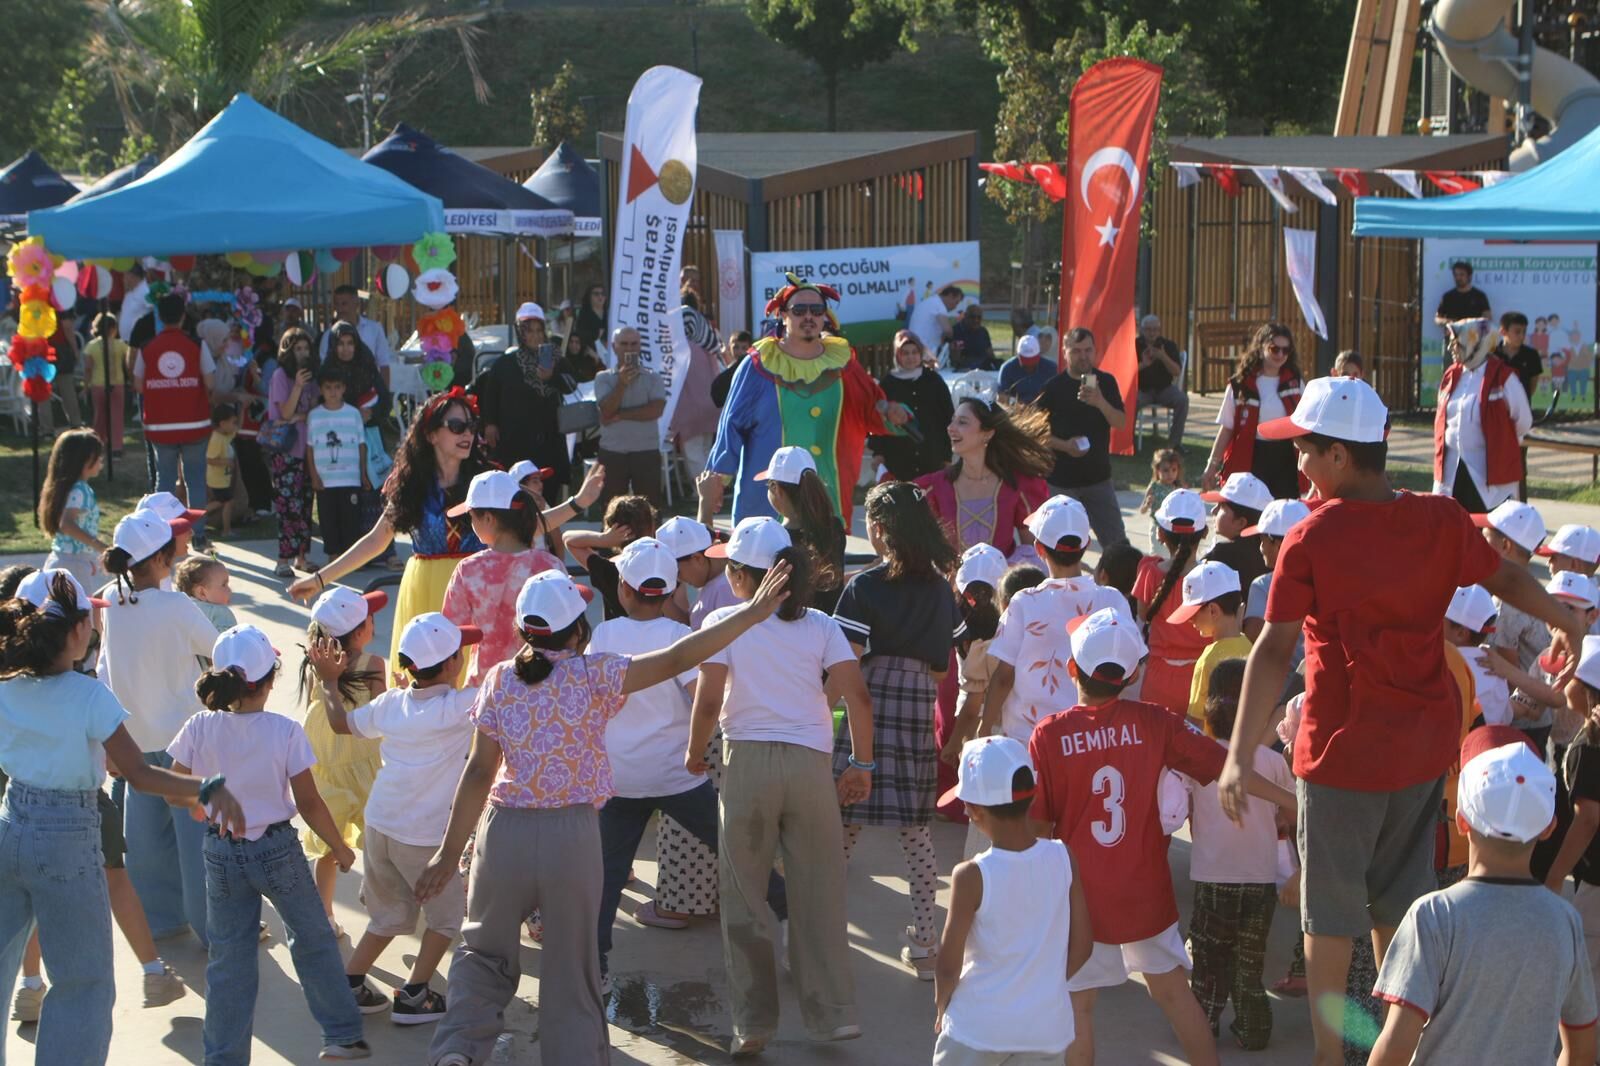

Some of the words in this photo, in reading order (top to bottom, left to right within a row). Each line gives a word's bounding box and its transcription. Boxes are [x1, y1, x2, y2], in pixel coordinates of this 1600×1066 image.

[444, 211, 497, 226] LEDİYESİ
[575, 220, 600, 231] ELEDİ
[654, 216, 678, 315] Belediyesi
[819, 258, 890, 279] ÇOCUĞUN
[1471, 257, 1520, 268] Haziran
[1524, 257, 1586, 271] Koruyucu
[636, 214, 662, 372] ramanmaraş
[1061, 723, 1143, 756] DEMİRAL
[1091, 765, 1127, 848] 3
